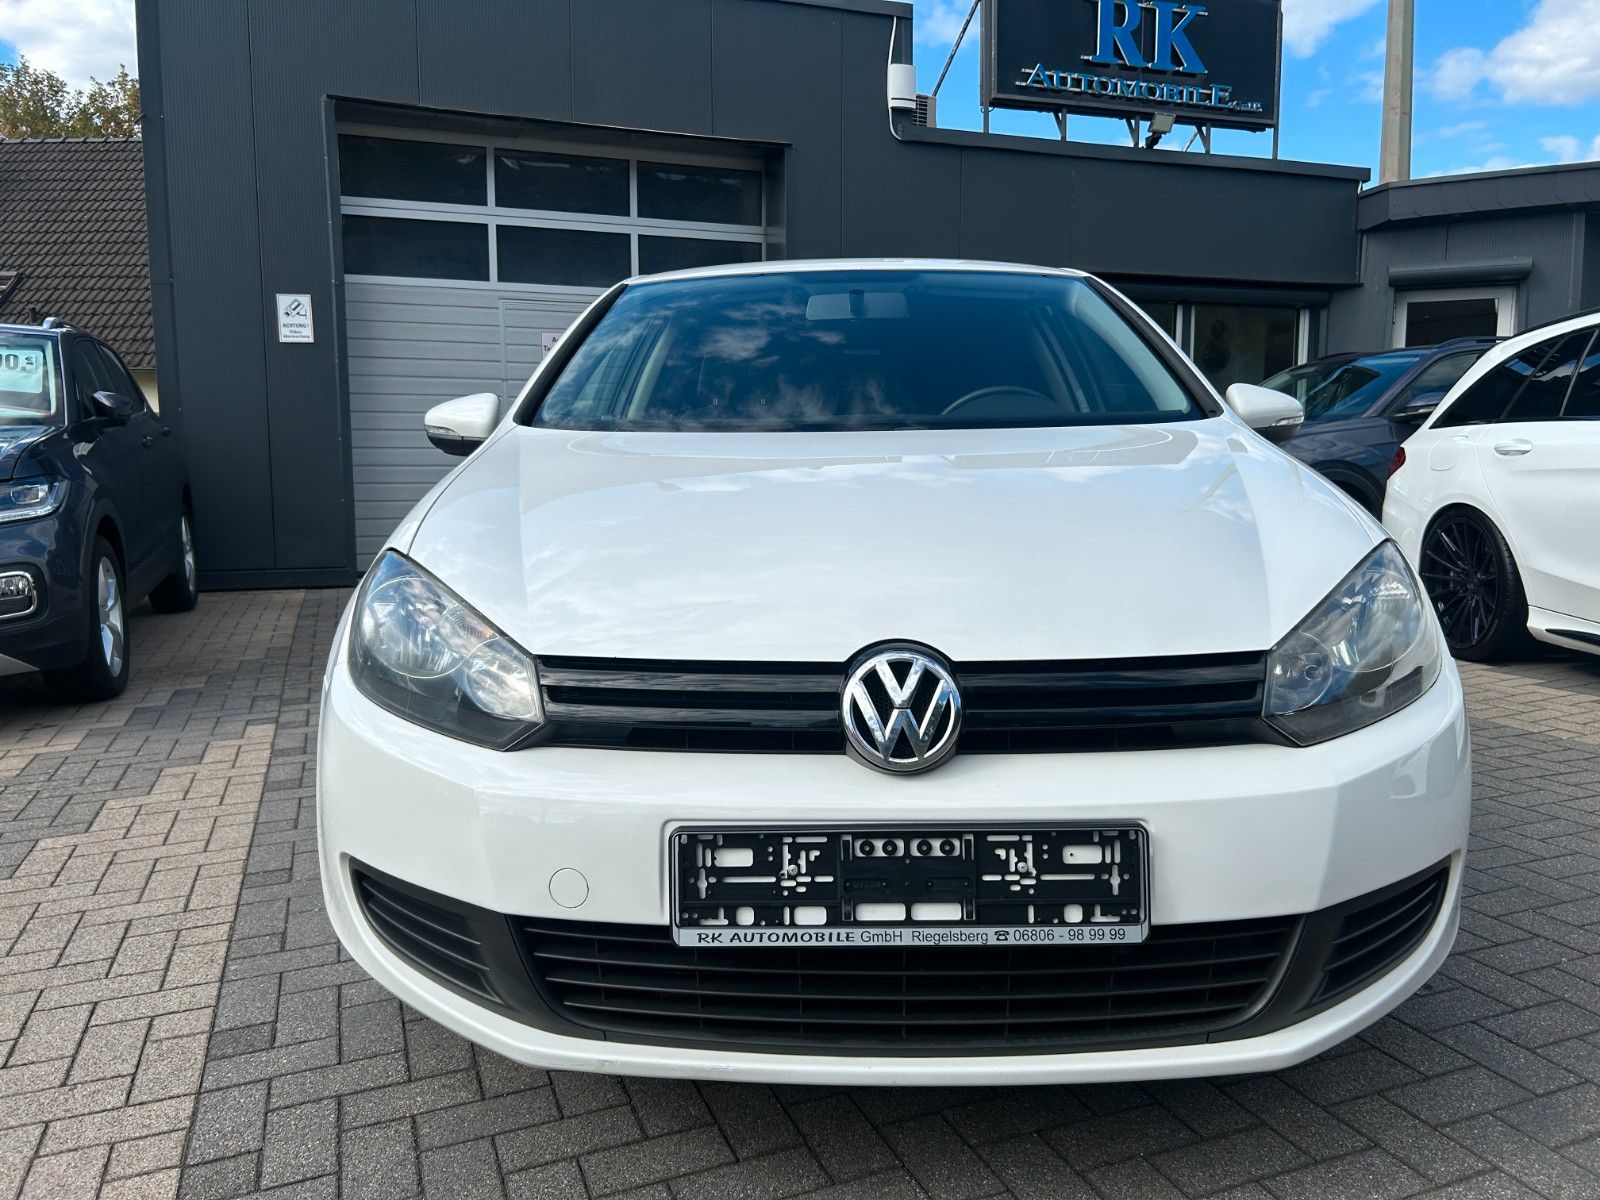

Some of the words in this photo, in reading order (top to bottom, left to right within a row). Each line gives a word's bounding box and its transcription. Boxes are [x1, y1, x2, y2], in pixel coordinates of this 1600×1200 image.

[1089, 0, 1208, 74] RK
[696, 932, 723, 944] RK
[729, 931, 856, 944] AUTOMOBILE
[860, 930, 903, 943] GmbH
[911, 929, 989, 945] Riegelsberg
[1013, 929, 1055, 942] 06806
[1067, 928, 1084, 941] 98
[1088, 928, 1105, 941] 99
[1109, 927, 1126, 940] 99
